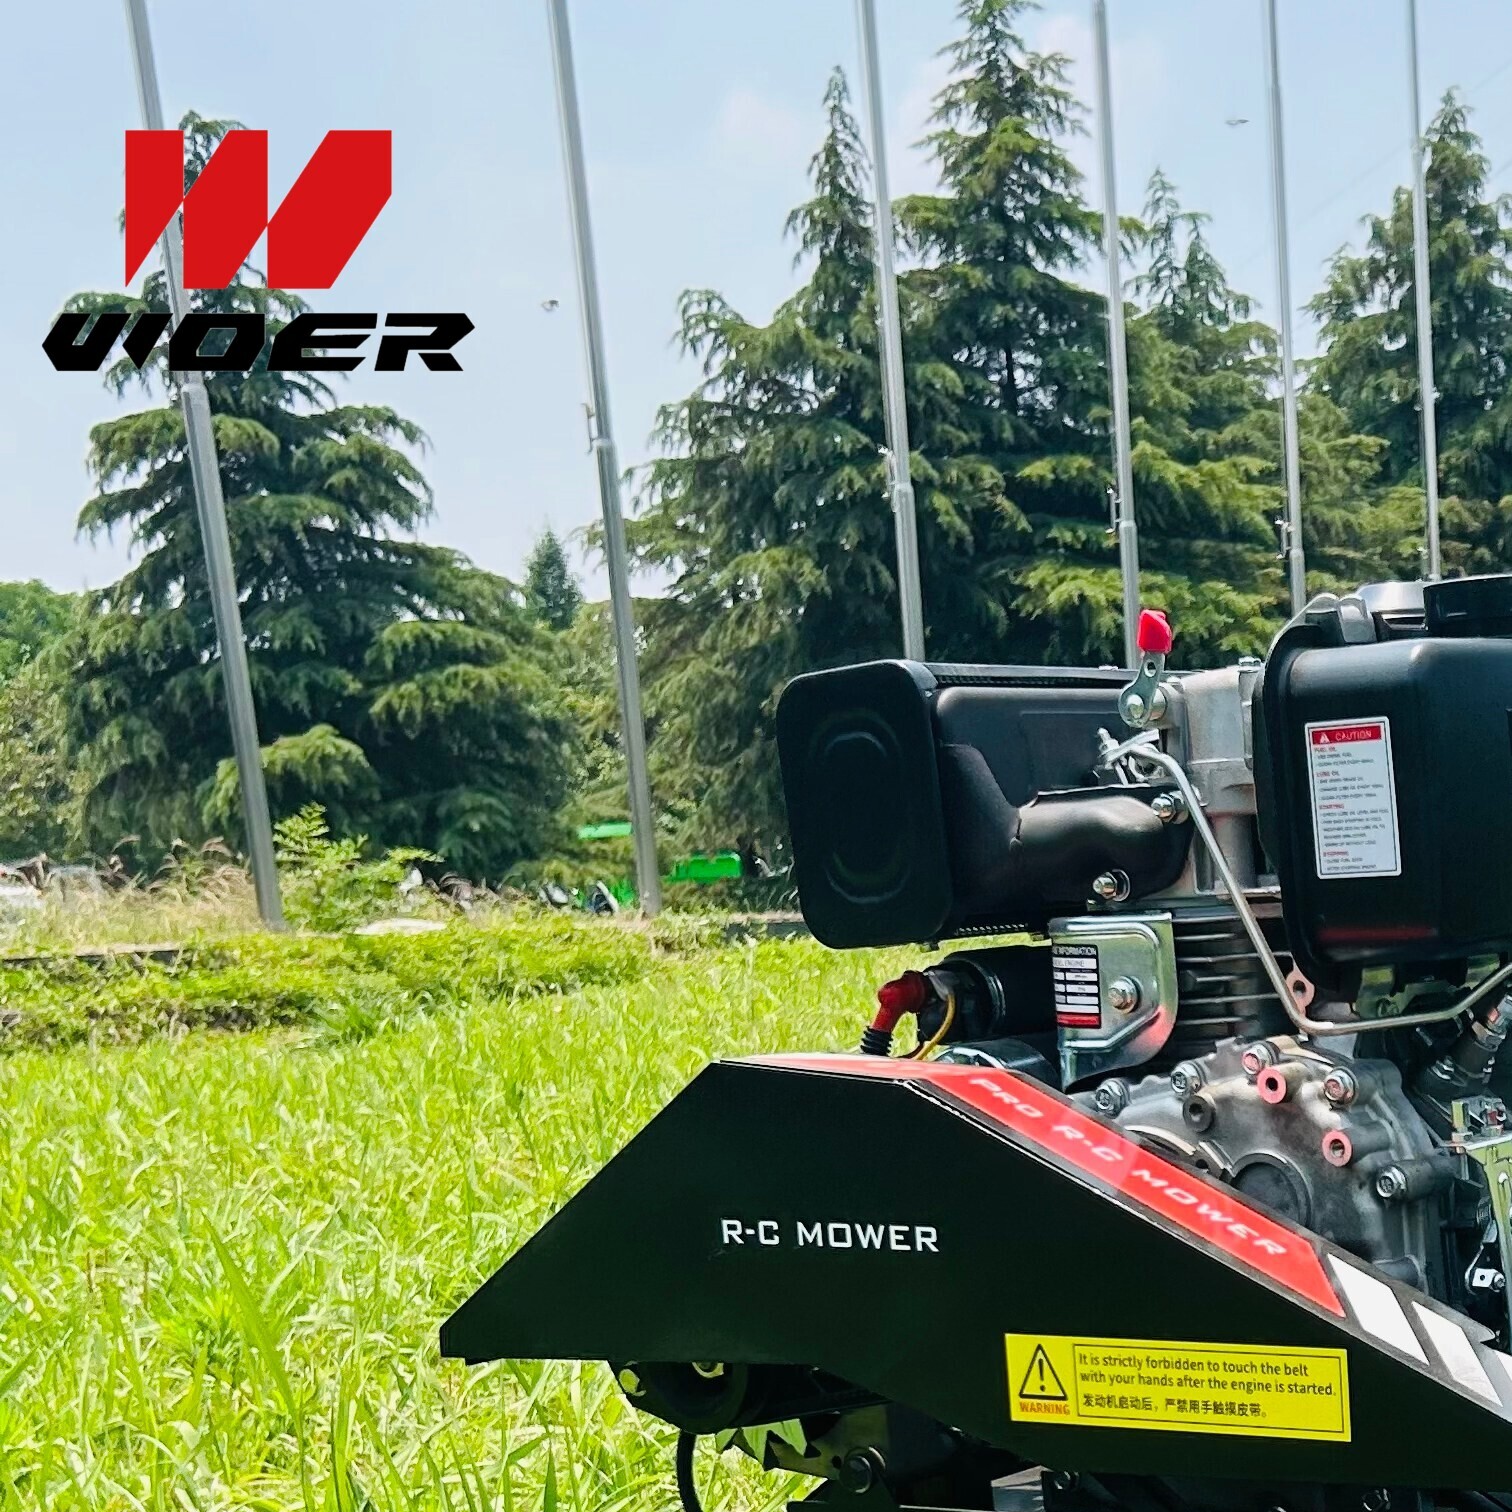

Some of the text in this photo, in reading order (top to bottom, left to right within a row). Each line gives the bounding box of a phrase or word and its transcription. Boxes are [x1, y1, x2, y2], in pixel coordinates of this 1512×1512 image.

[1335, 730, 1372, 742] CAUTION
[969, 1078, 1044, 1118] PRO
[1131, 1168, 1288, 1256] MOWER
[721, 1218, 940, 1252] R-C MOWER
[1079, 1353, 1309, 1376] It is strictly forbidden to touch the belt
[1080, 1370, 1106, 1383] with
[1108, 1375, 1135, 1387] your
[1138, 1373, 1174, 1387] hands
[1177, 1375, 1205, 1388] after
[1208, 1376, 1228, 1390] the
[1231, 1378, 1272, 1394] engine
[1275, 1380, 1285, 1393] is
[1019, 1401, 1071, 1415] WARNING
